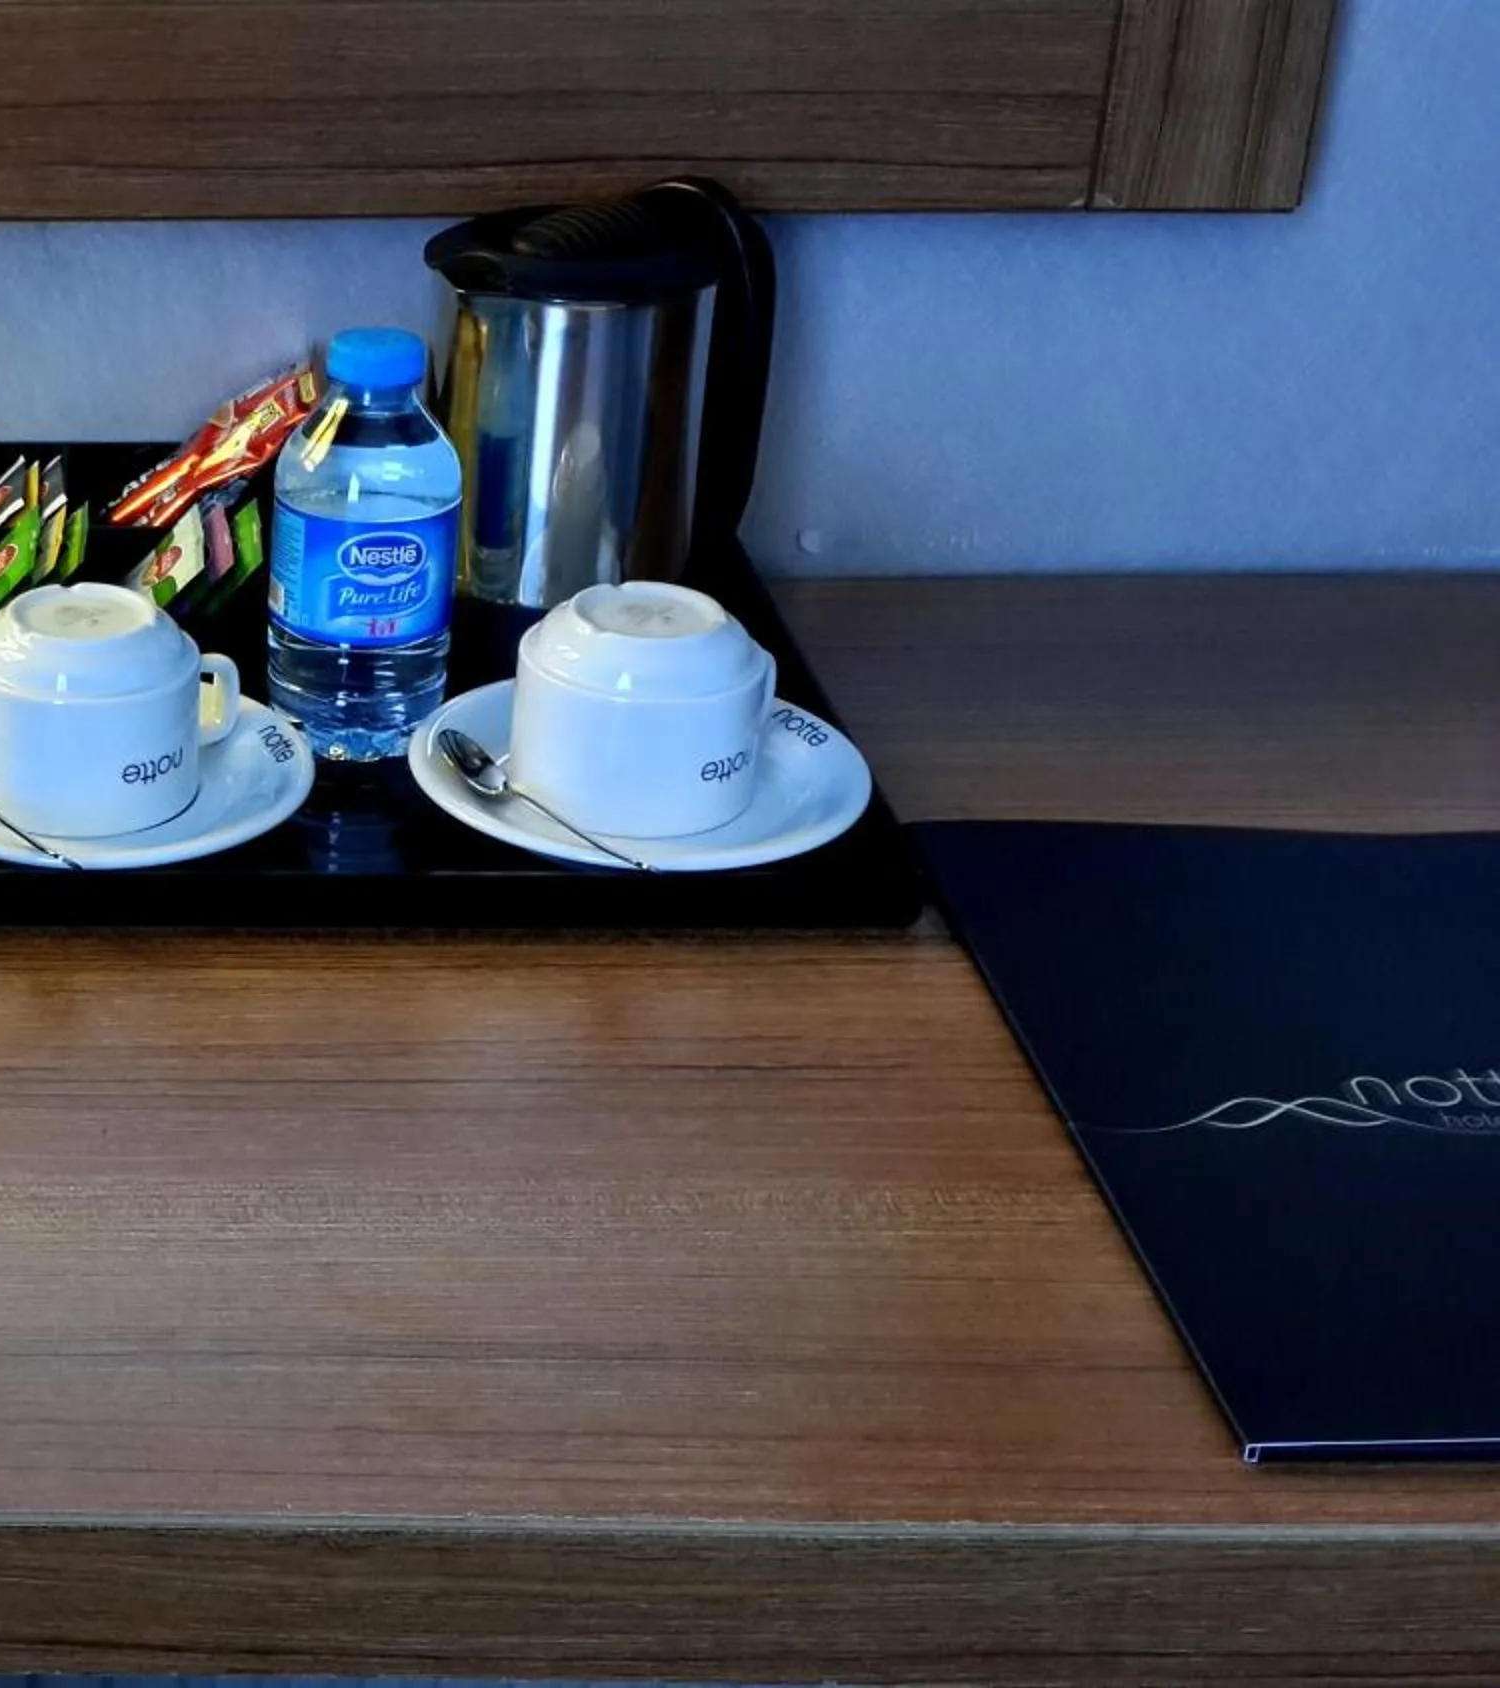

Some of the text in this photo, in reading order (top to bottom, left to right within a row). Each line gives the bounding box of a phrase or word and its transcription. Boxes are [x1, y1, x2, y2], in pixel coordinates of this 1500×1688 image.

[338, 580, 421, 607] Pure Life
[257, 724, 296, 764] notte
[771, 707, 829, 747] notte
[121, 745, 184, 785] notte
[701, 751, 751, 783] otte
